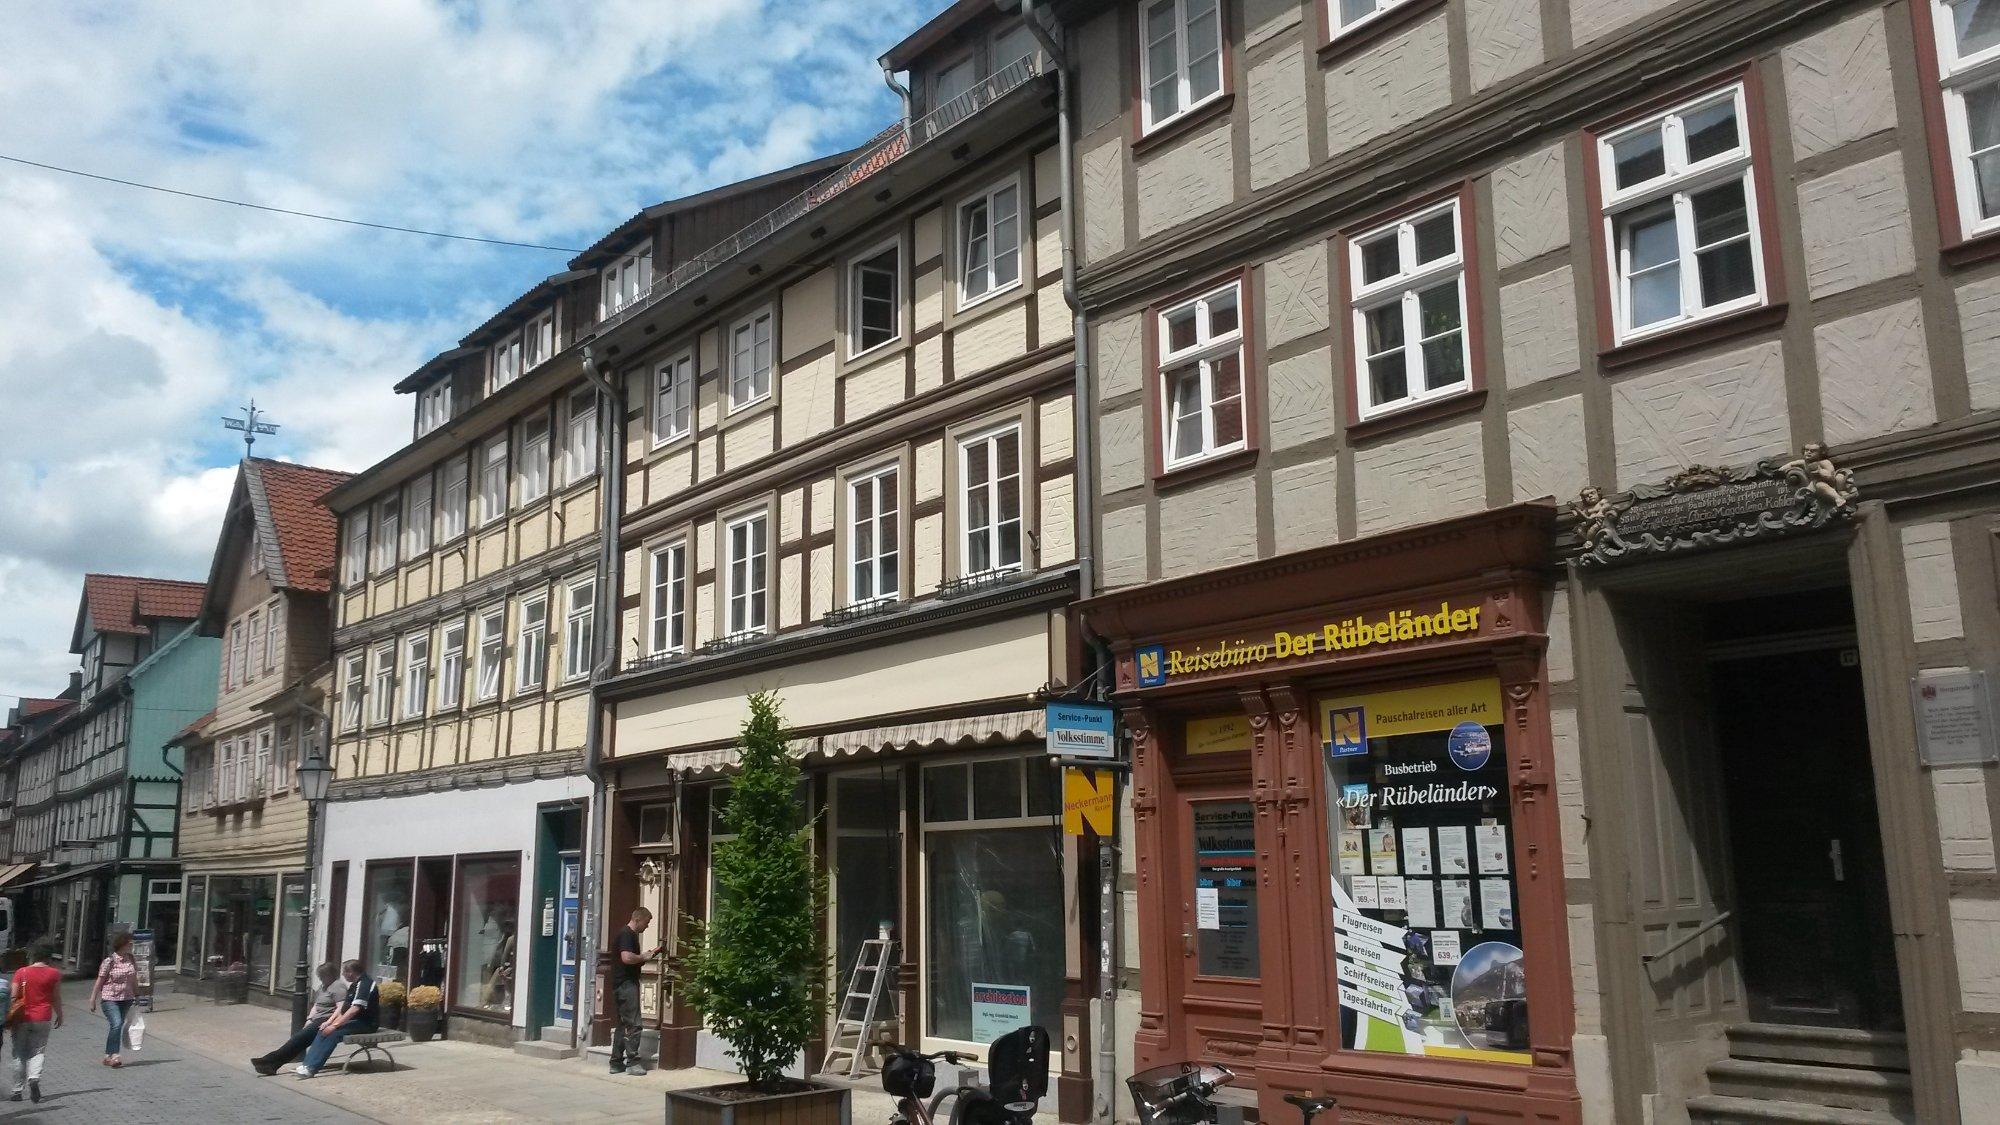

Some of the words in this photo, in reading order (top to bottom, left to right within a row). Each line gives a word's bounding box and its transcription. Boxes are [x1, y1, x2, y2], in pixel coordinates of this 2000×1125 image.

[1168, 640, 1268, 676] Reisebüro
[1274, 631, 1318, 659] Der
[1323, 602, 1482, 652] Rübeländer
[1058, 712, 1103, 724] Service-Punkt
[1376, 709, 1444, 724] Pauschalreisen
[1446, 705, 1468, 717] aller
[1470, 702, 1487, 714] Art
[1056, 730, 1105, 744] Volksstimme
[1384, 760, 1437, 776] Busbetrieb
[1065, 793, 1113, 812] Neckermann
[1382, 781, 1498, 806] Rübeländer»
[1342, 914, 1382, 935] Flugreisen
[1343, 940, 1381, 960] Busreisen
[1343, 966, 1394, 992] Schiffsreisen
[1342, 990, 1393, 1016] Tagesfahrten
